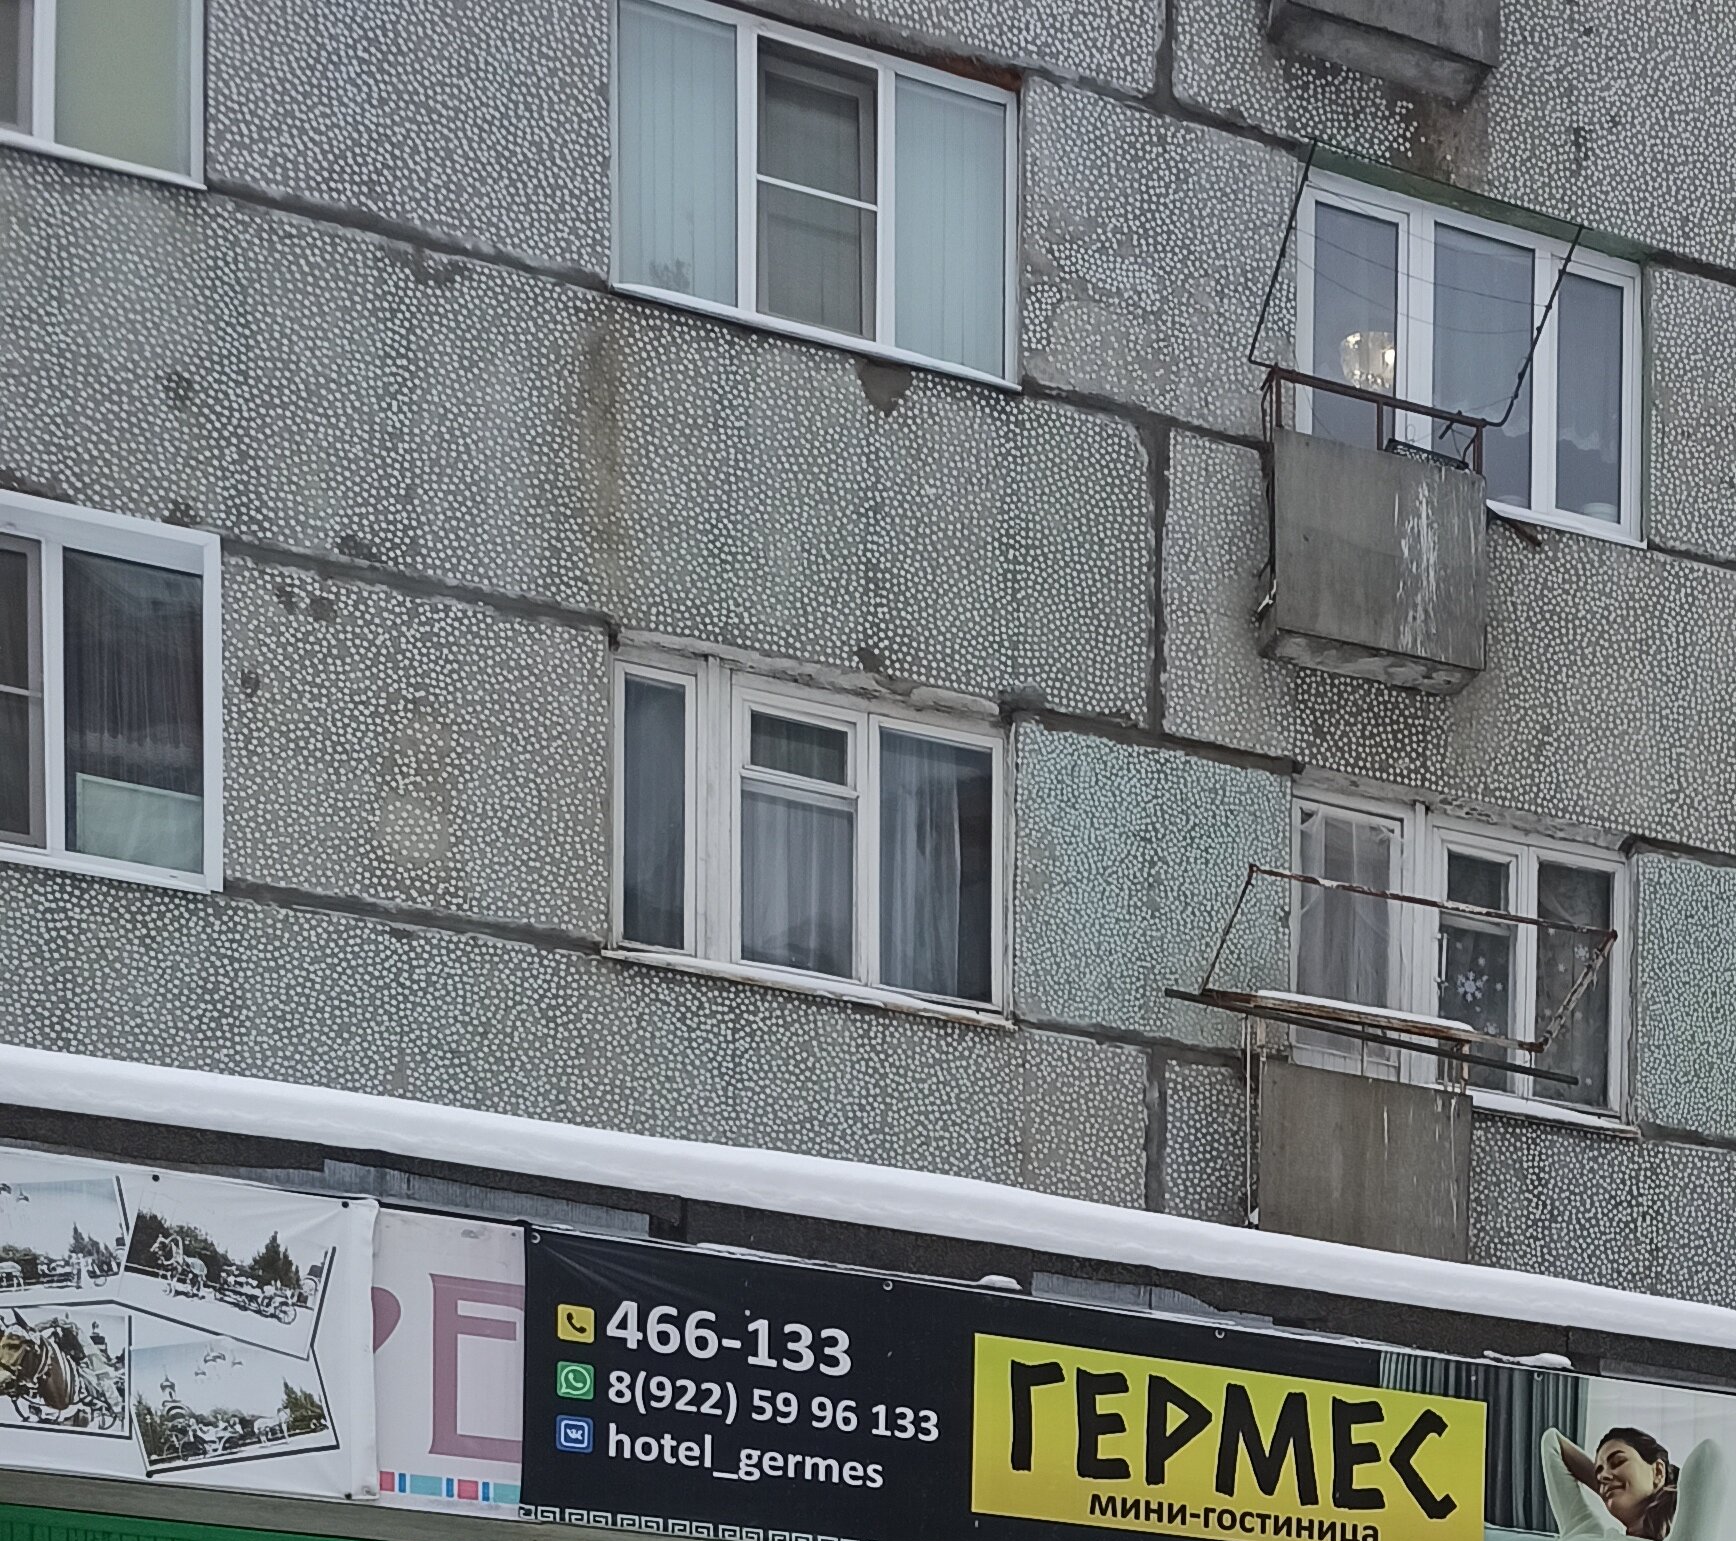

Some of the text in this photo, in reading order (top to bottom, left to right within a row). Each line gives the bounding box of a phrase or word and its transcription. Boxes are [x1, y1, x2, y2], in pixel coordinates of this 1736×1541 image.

[606, 1301, 852, 1377] 466-133
[608, 1370, 940, 1442] 8(922) 59 96 133
[1010, 1359, 1458, 1520] ГЕРМЕС
[608, 1423, 884, 1489] hotel_germes
